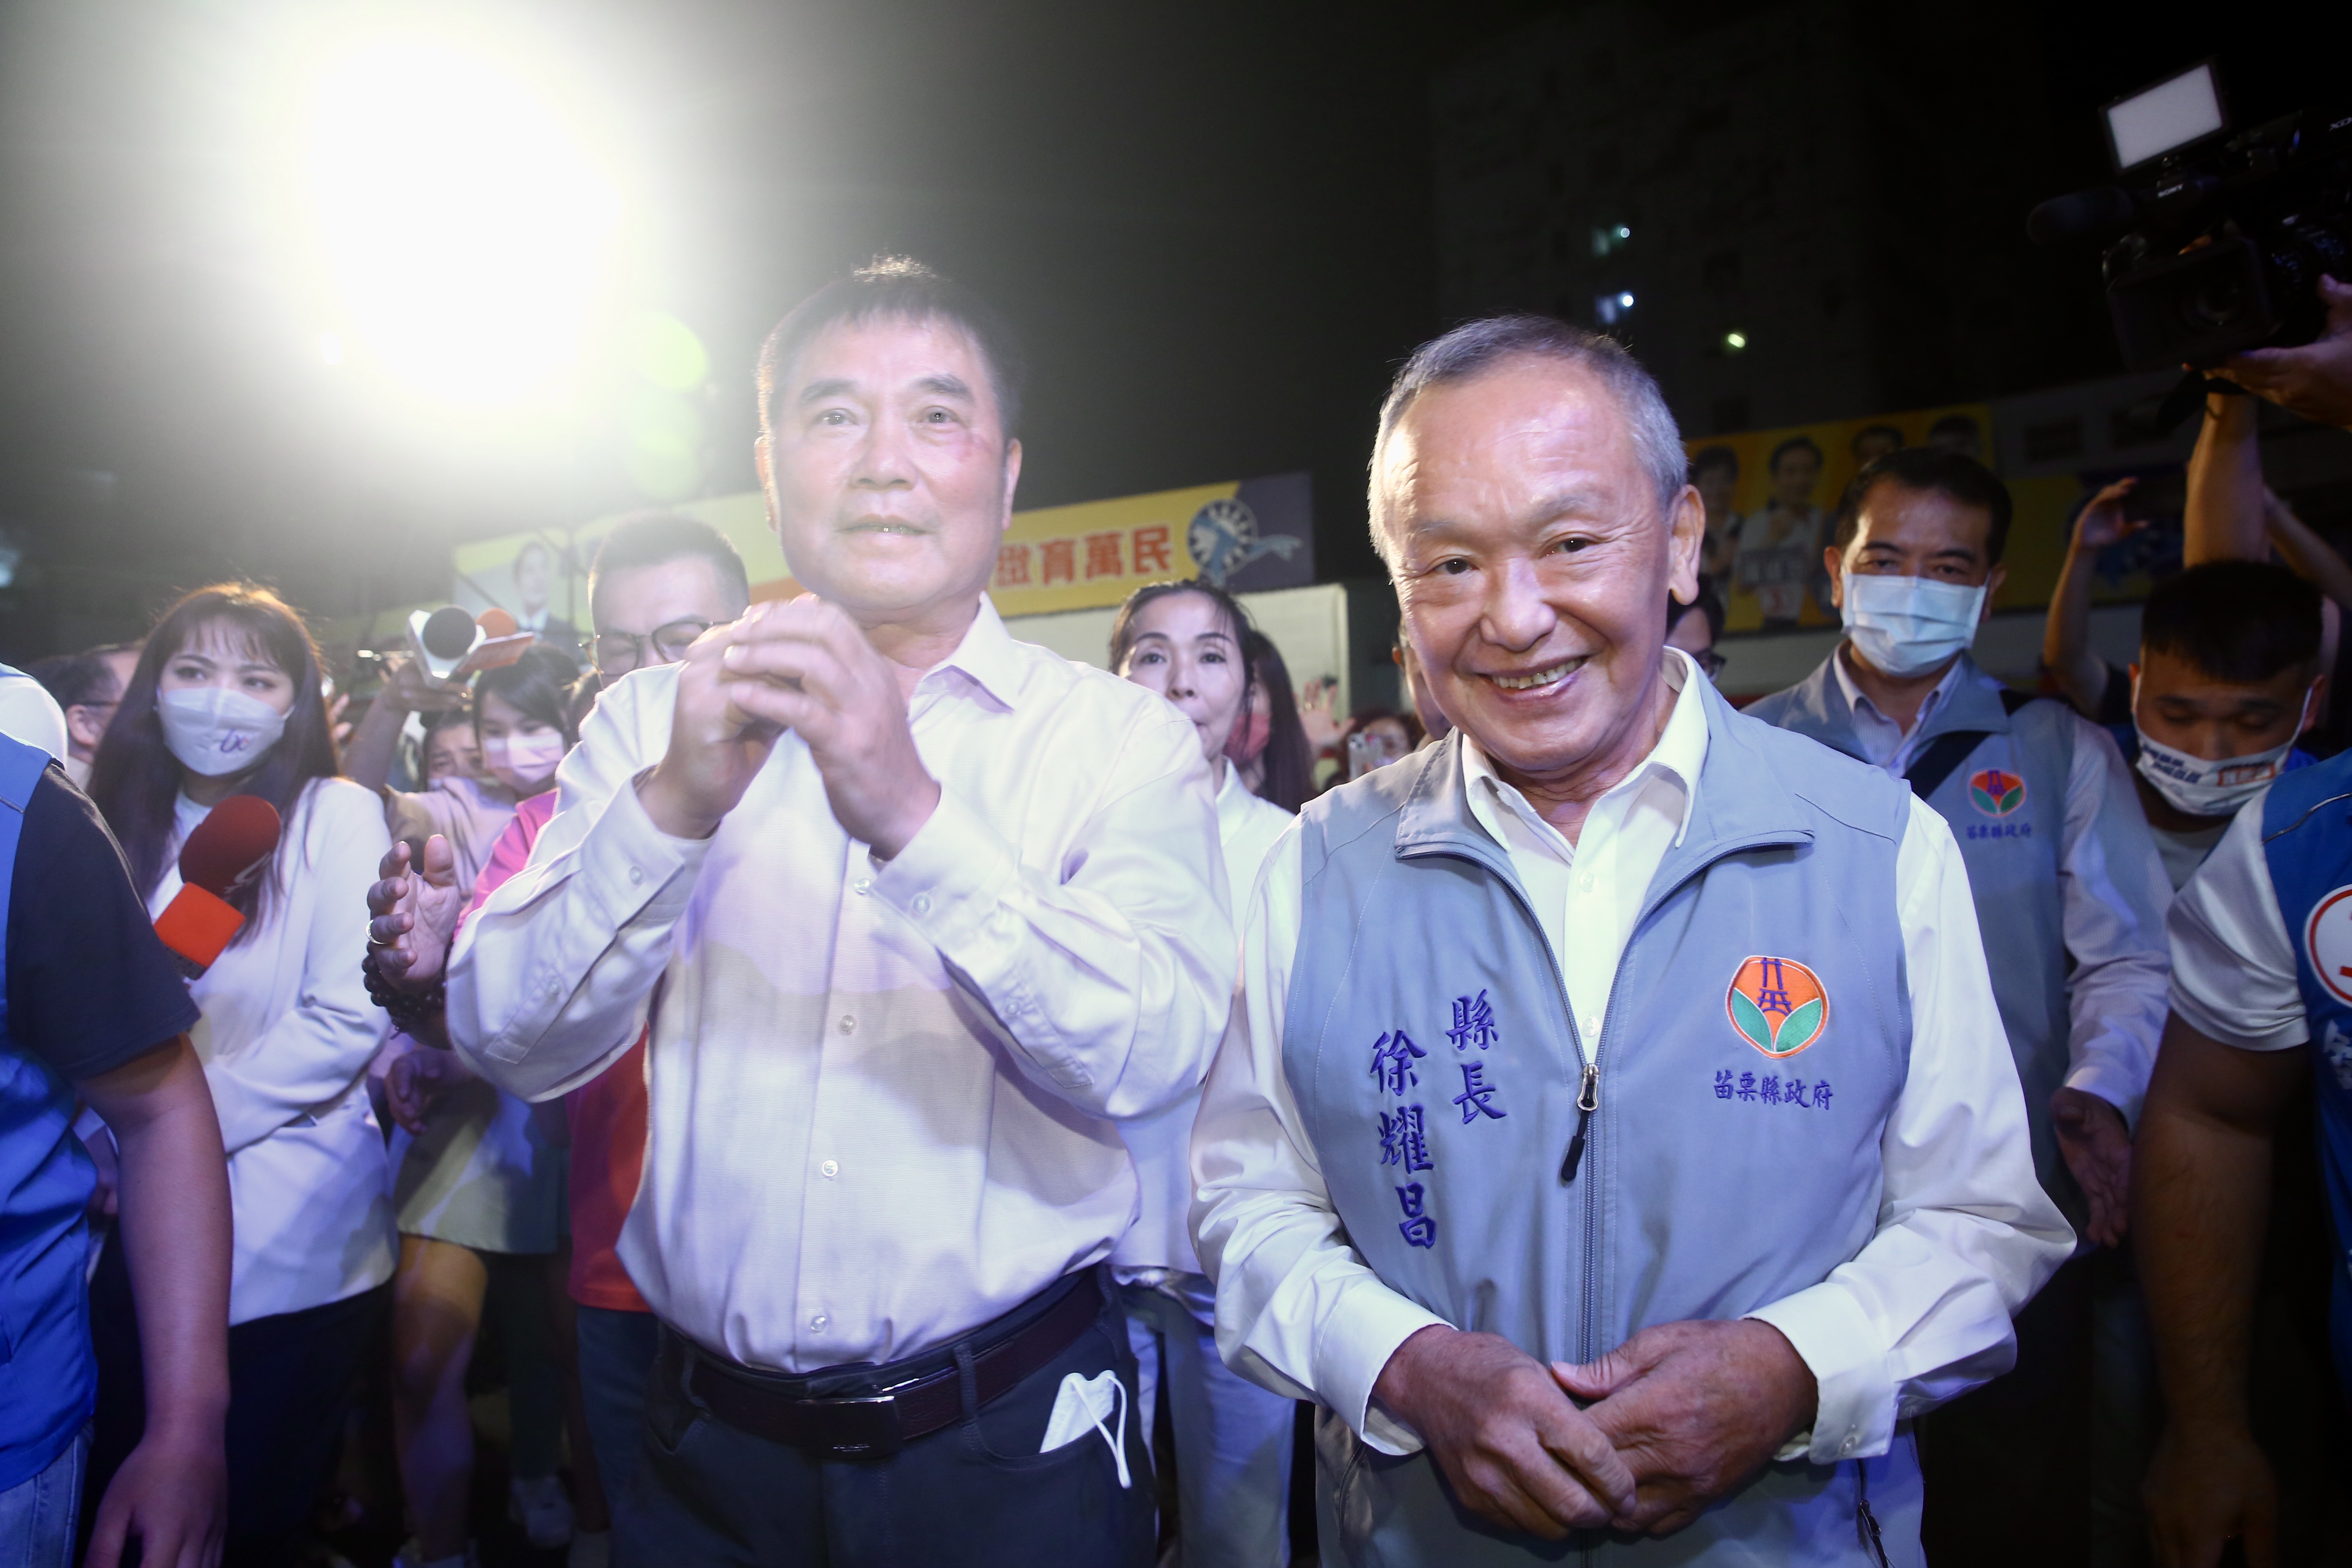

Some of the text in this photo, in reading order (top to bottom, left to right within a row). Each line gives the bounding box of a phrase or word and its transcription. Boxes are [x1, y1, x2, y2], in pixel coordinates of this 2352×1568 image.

[1446, 989, 1507, 1125] 縣長
[1713, 1069, 1833, 1111] 苗栗縣政府
[1370, 1029, 1437, 1250] 徐耀昌
